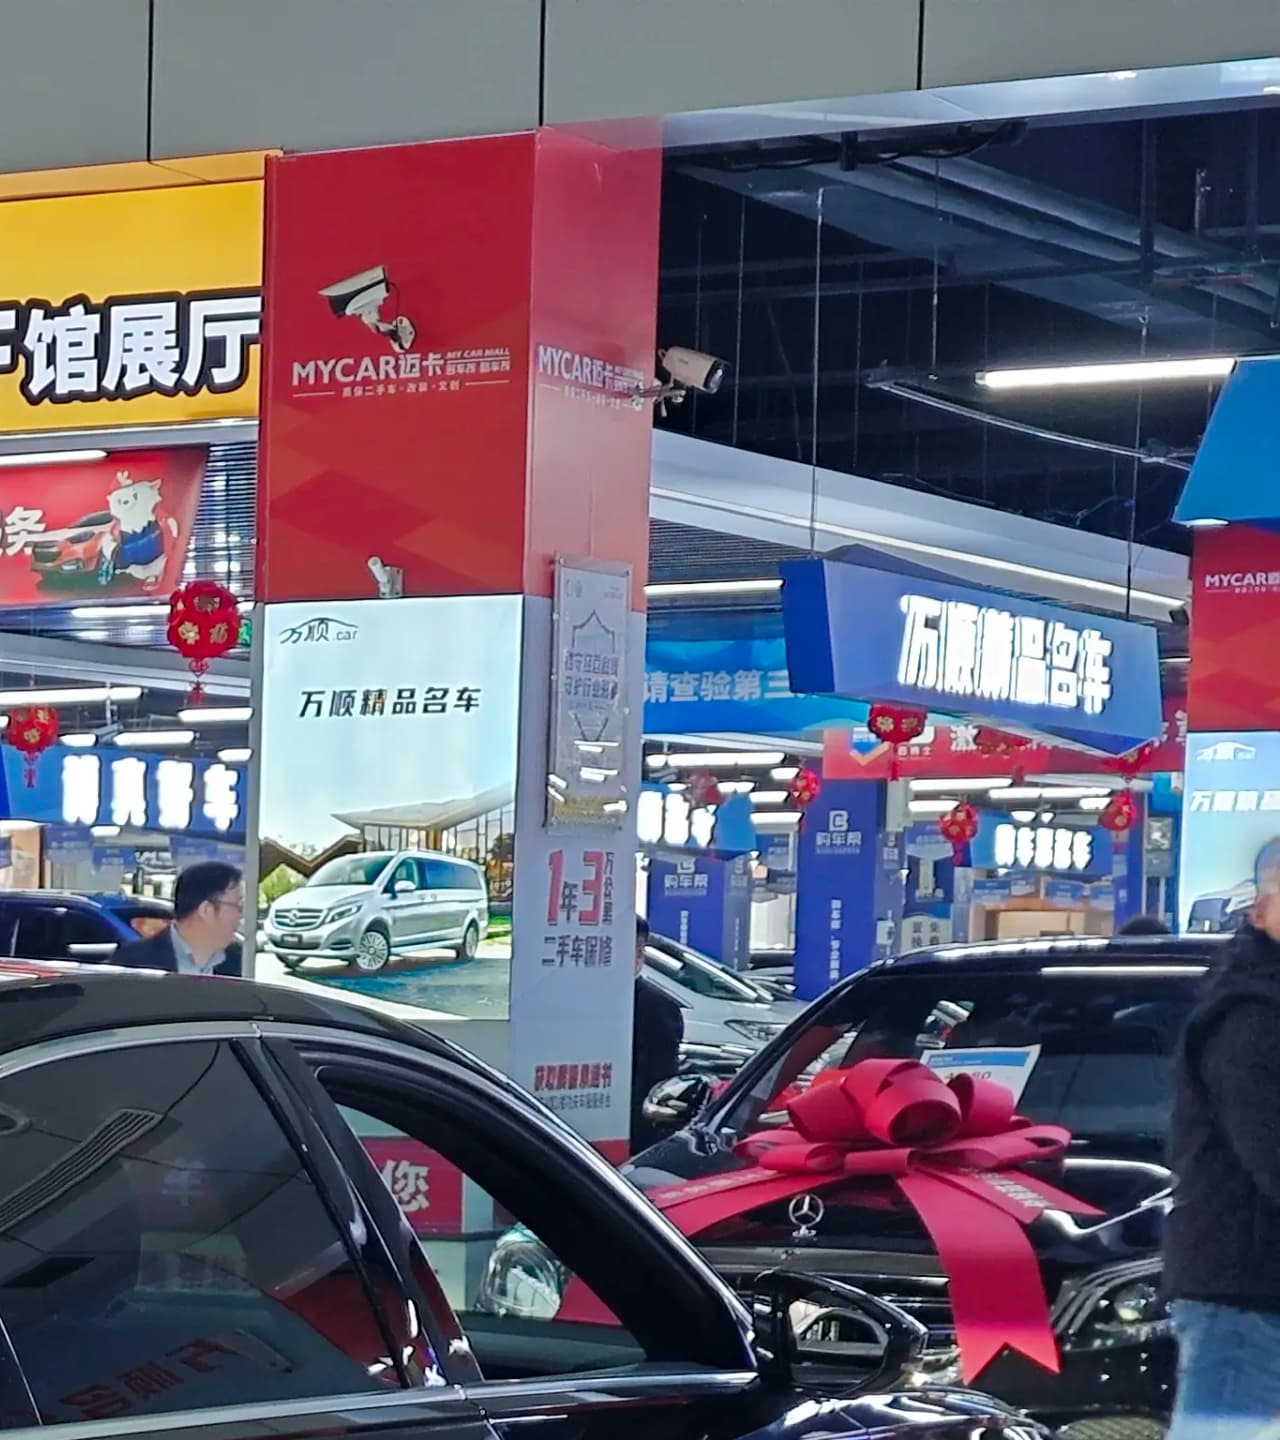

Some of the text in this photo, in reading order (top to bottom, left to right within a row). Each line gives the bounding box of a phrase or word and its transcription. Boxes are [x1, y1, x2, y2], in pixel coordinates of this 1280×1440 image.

[292, 352, 444, 387] MYCAR迈卡
[298, 686, 482, 719] 万顺精品名车
[541, 934, 613, 968] 二手车保修
[382, 1159, 430, 1213] 您
